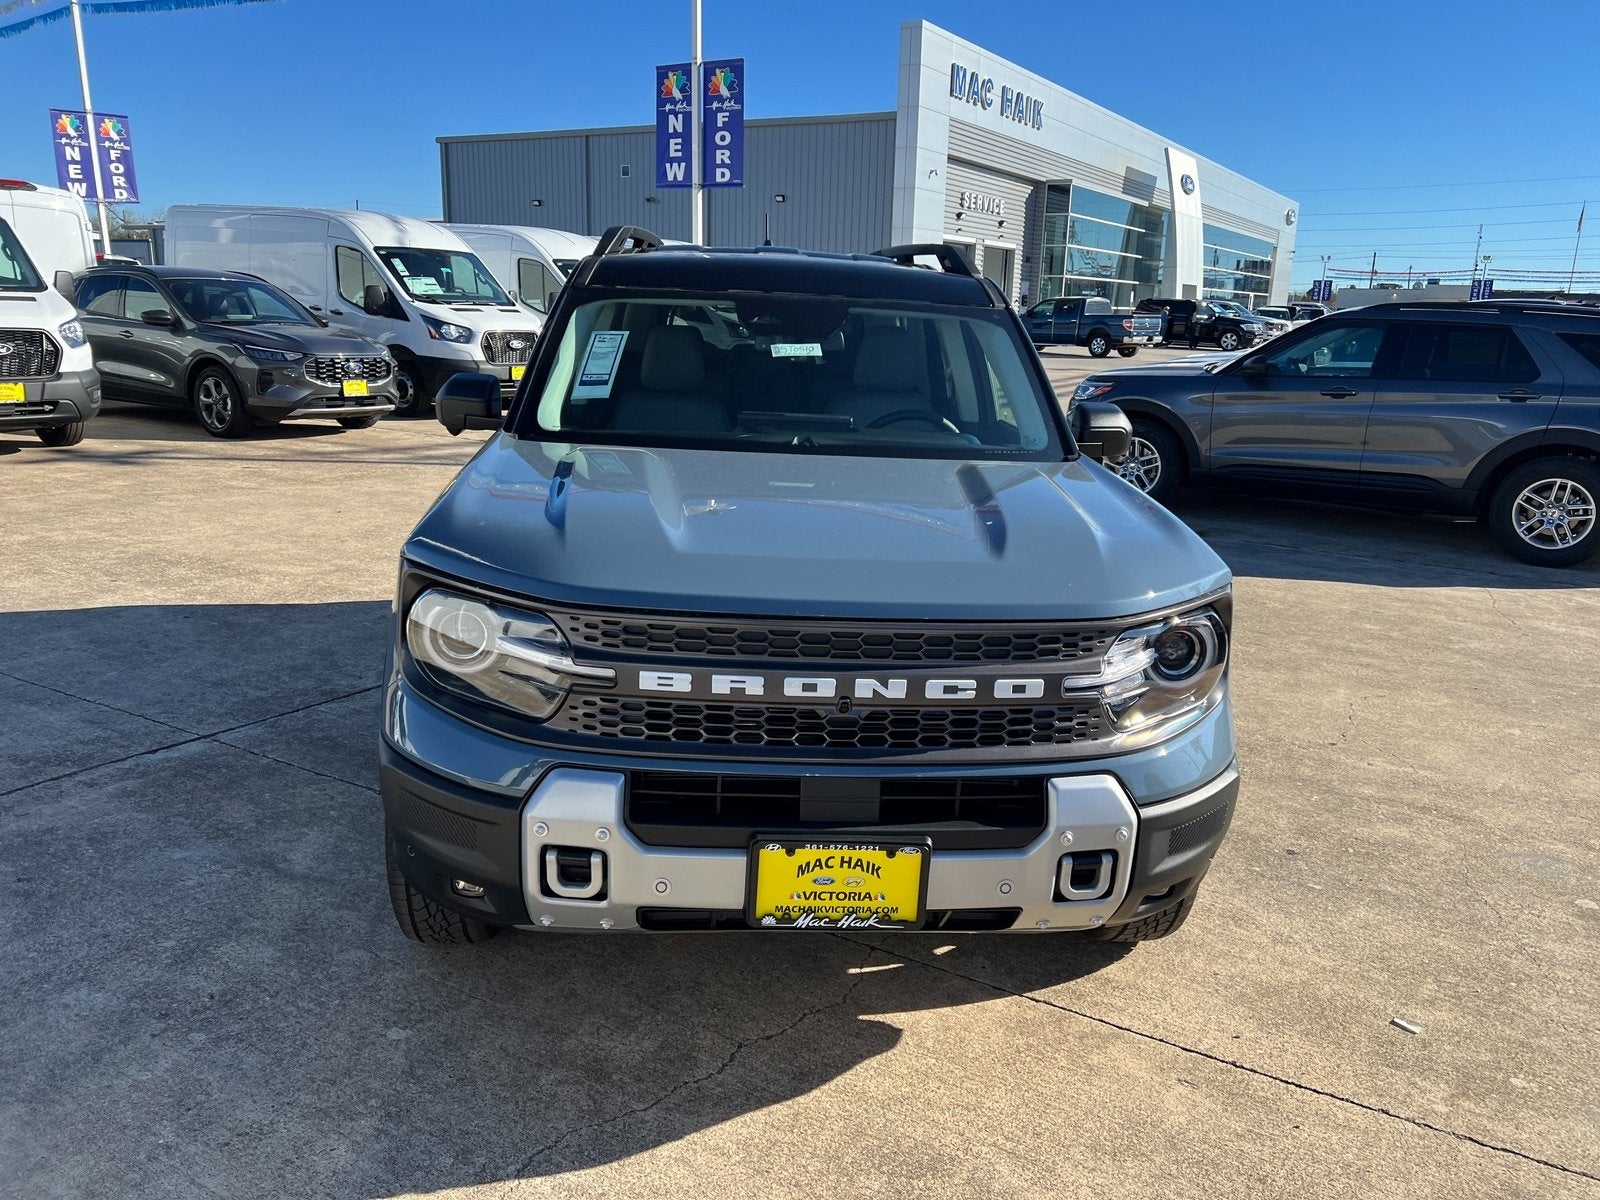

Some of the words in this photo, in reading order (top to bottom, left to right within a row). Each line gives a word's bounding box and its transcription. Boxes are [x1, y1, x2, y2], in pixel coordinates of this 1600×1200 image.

[950, 62, 994, 110] MAC
[1000, 85, 1044, 131] HAIK
[665, 113, 686, 181] NEW
[714, 112, 732, 183] FORD
[64, 146, 87, 197] NEW
[109, 149, 128, 200] FORD
[961, 191, 1006, 215] SERVICE
[639, 670, 1045, 699] BRONCO
[796, 855, 836, 878] MAC
[839, 855, 882, 880] HAIK
[774, 905, 899, 914] MACHAIKVICTORIA.COM
[803, 891, 873, 901] VICTORIA
[793, 912, 834, 928] Mac
[837, 912, 882, 928] Haik
